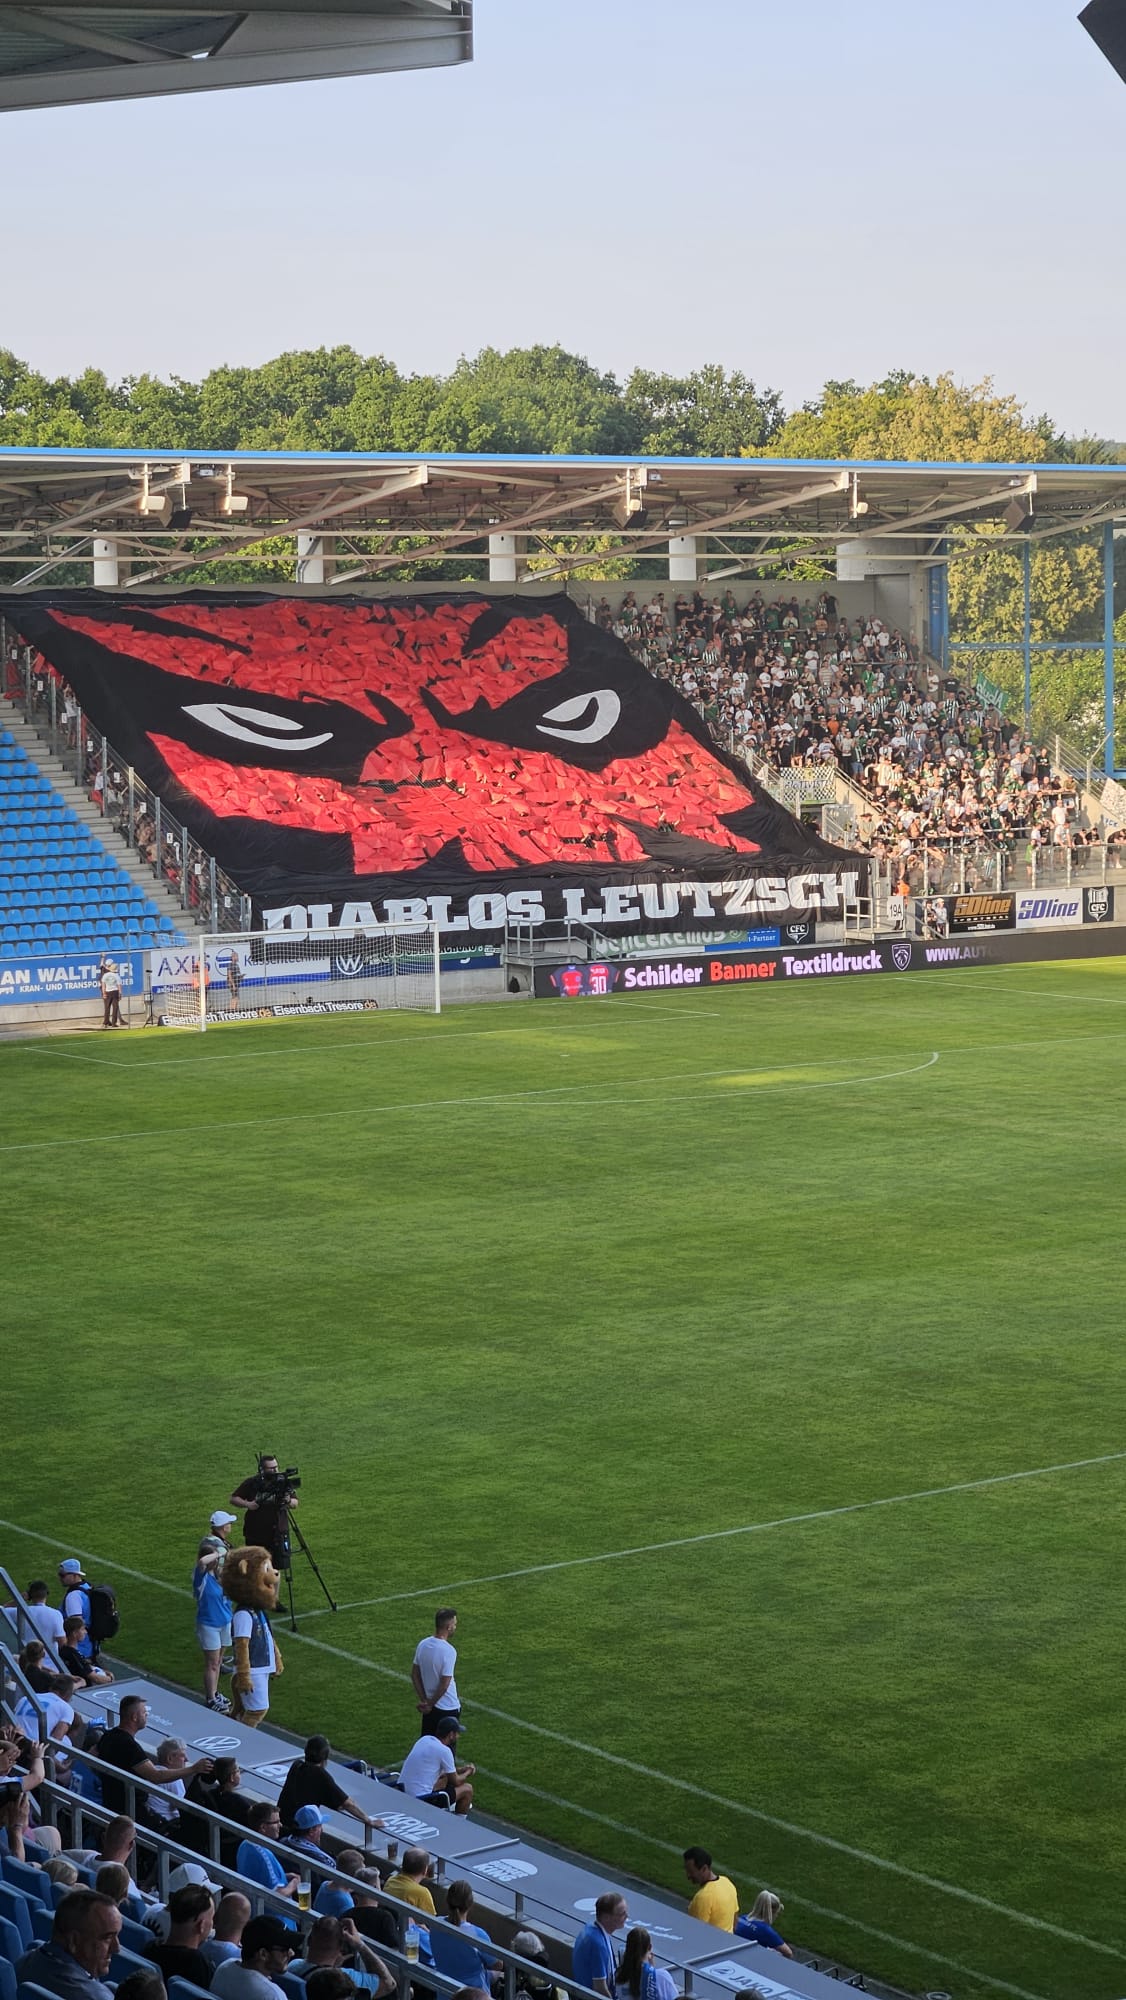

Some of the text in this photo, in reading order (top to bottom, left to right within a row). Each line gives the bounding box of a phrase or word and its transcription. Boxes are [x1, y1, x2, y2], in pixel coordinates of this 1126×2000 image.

[262, 871, 859, 943] DIABLOS LEUTZSCH
[889, 904, 902, 917] 19A
[1018, 899, 1079, 919] SDline
[1090, 903, 1106, 911] CFC
[789, 924, 806, 933] CFC
[37, 963, 134, 983] WALTHR
[624, 950, 883, 988] Schilder Banner Textildruck
[20, 984, 43, 993] KRAN-
[45, 983, 62, 992] UND
[591, 975, 607, 995] 30
